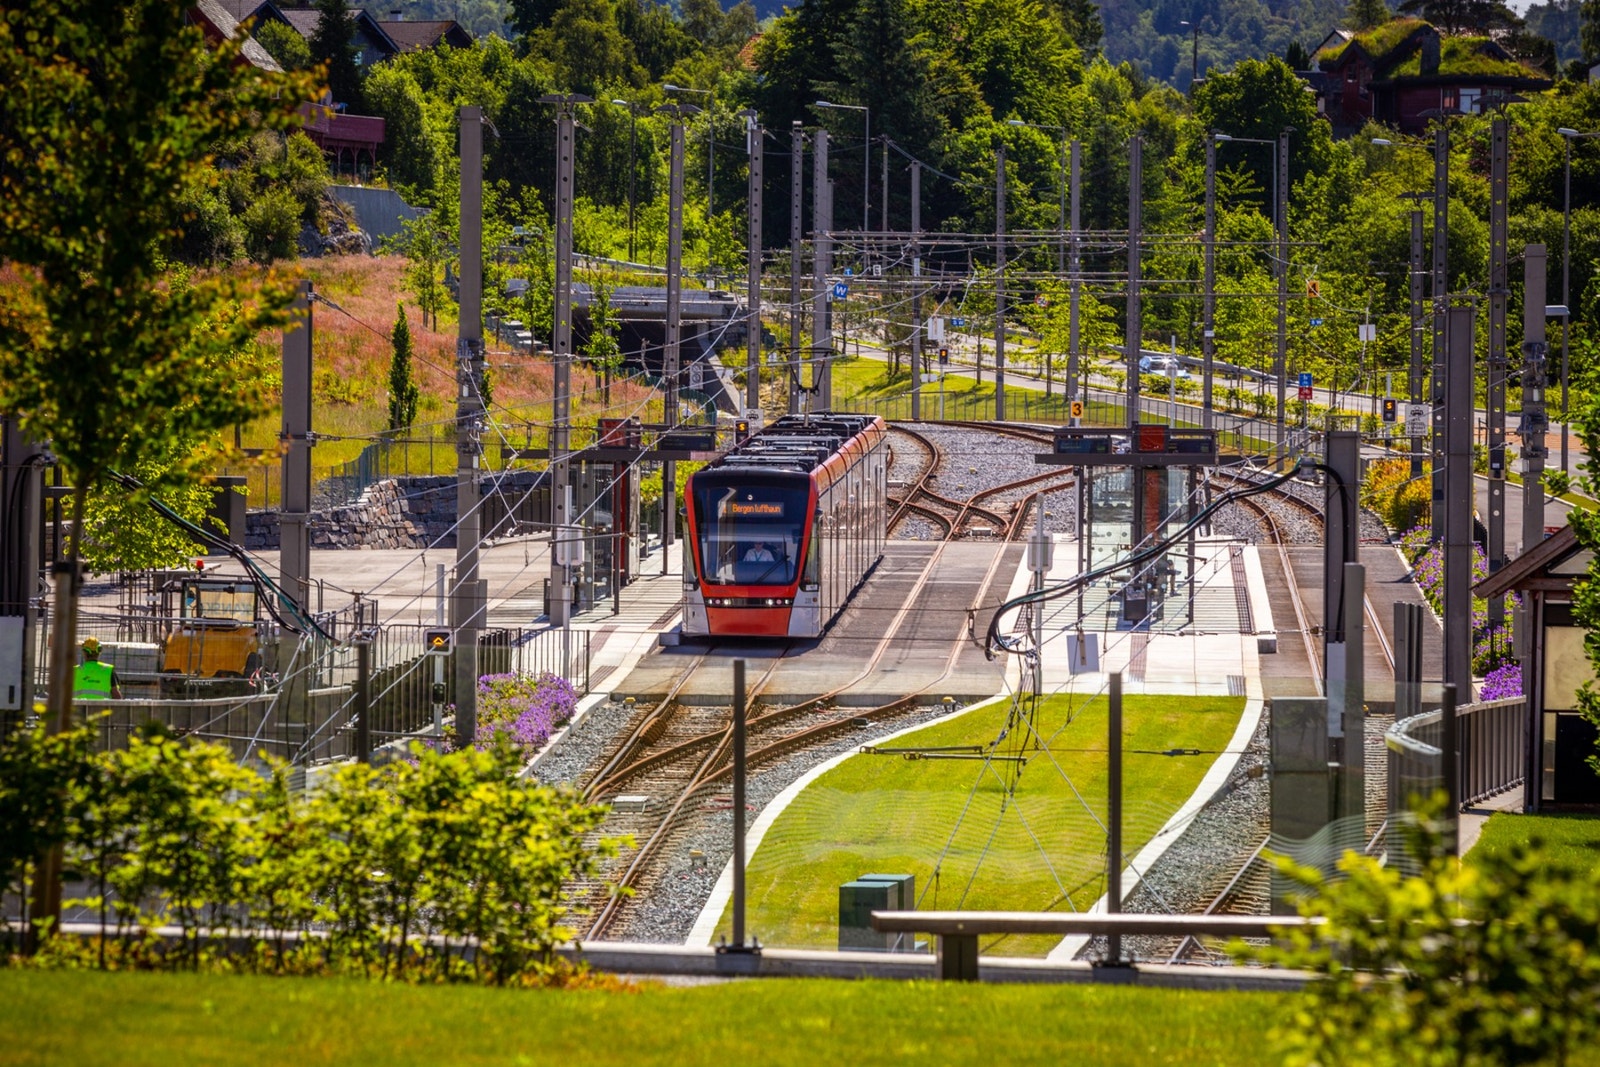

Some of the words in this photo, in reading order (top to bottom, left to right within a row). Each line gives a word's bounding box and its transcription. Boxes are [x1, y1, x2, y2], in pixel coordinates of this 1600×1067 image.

[1308, 283, 1318, 296] 4
[1072, 402, 1082, 416] 3
[732, 503, 754, 514] Bergen
